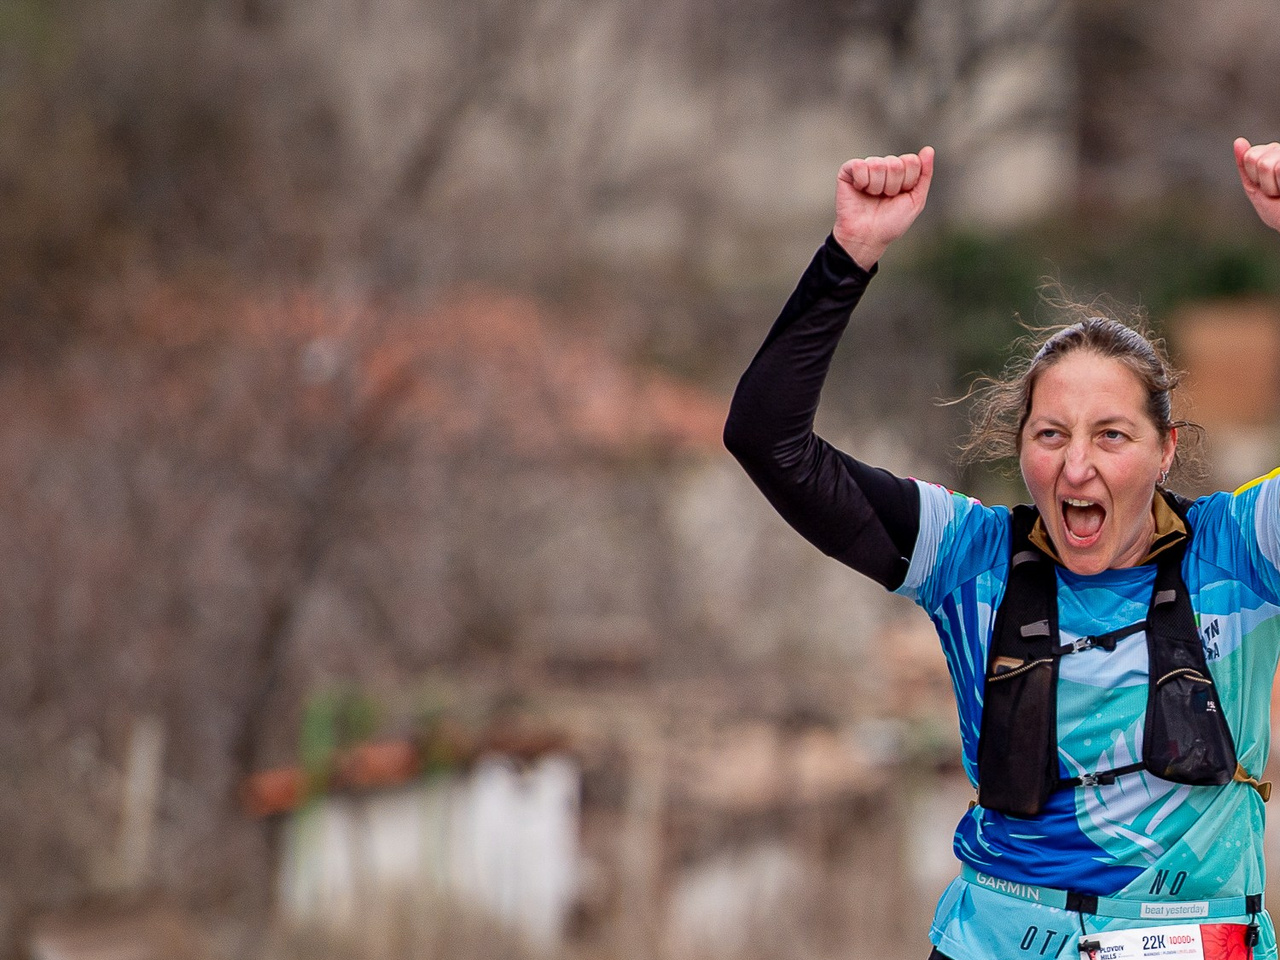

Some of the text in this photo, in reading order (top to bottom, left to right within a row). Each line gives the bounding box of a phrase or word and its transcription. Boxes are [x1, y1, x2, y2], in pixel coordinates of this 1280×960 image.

[976, 872, 1040, 901] GARMIN
[1145, 905, 1164, 915] beat
[1142, 934, 1166, 950] 22K
[1100, 952, 1117, 960] HILLS
